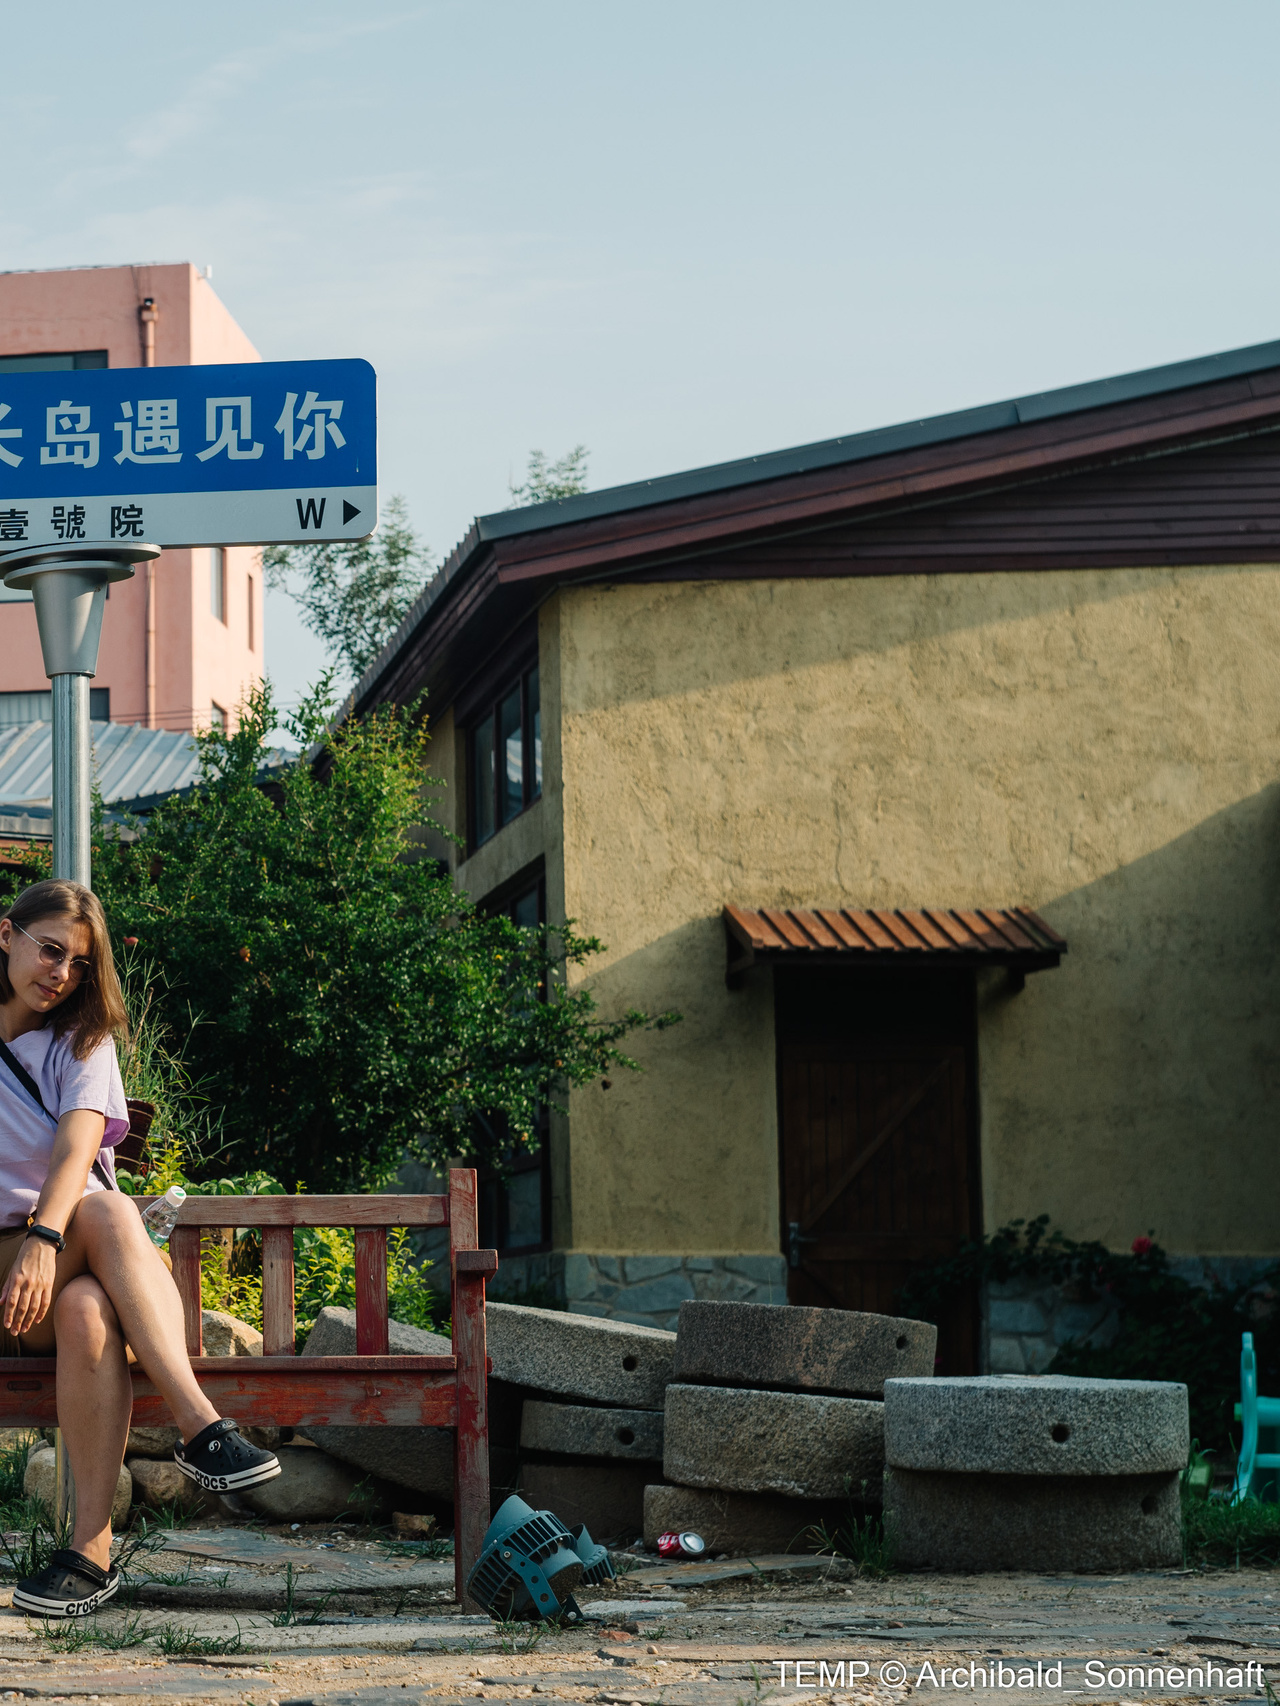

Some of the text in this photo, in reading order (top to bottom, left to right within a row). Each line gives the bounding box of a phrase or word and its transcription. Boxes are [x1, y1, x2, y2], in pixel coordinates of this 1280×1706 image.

[296, 498, 327, 530] W
[194, 1469, 228, 1490] crocs
[65, 1594, 99, 1615] crocs
